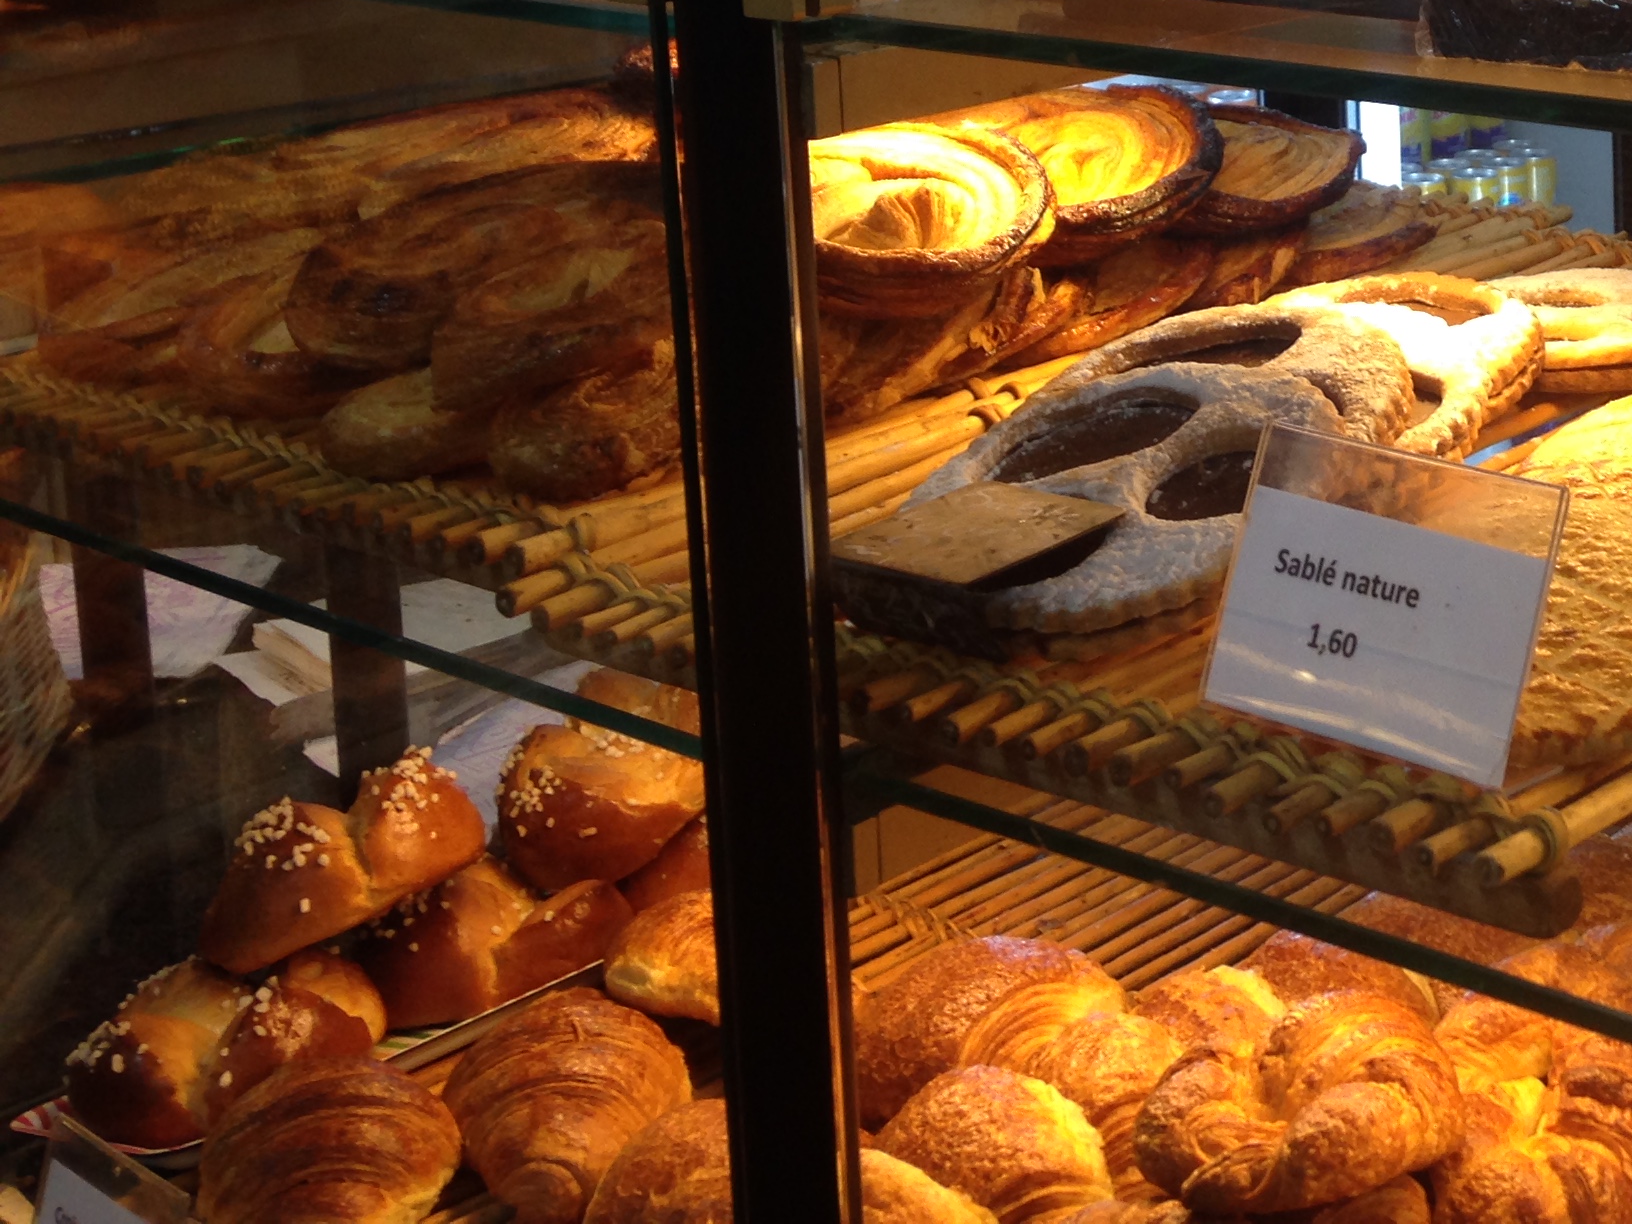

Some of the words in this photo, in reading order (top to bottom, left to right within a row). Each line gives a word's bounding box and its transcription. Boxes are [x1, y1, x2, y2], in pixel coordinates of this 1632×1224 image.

[1273, 548, 1337, 587] Sablé
[1340, 570, 1420, 608] nature
[1306, 623, 1358, 658] 1,60
